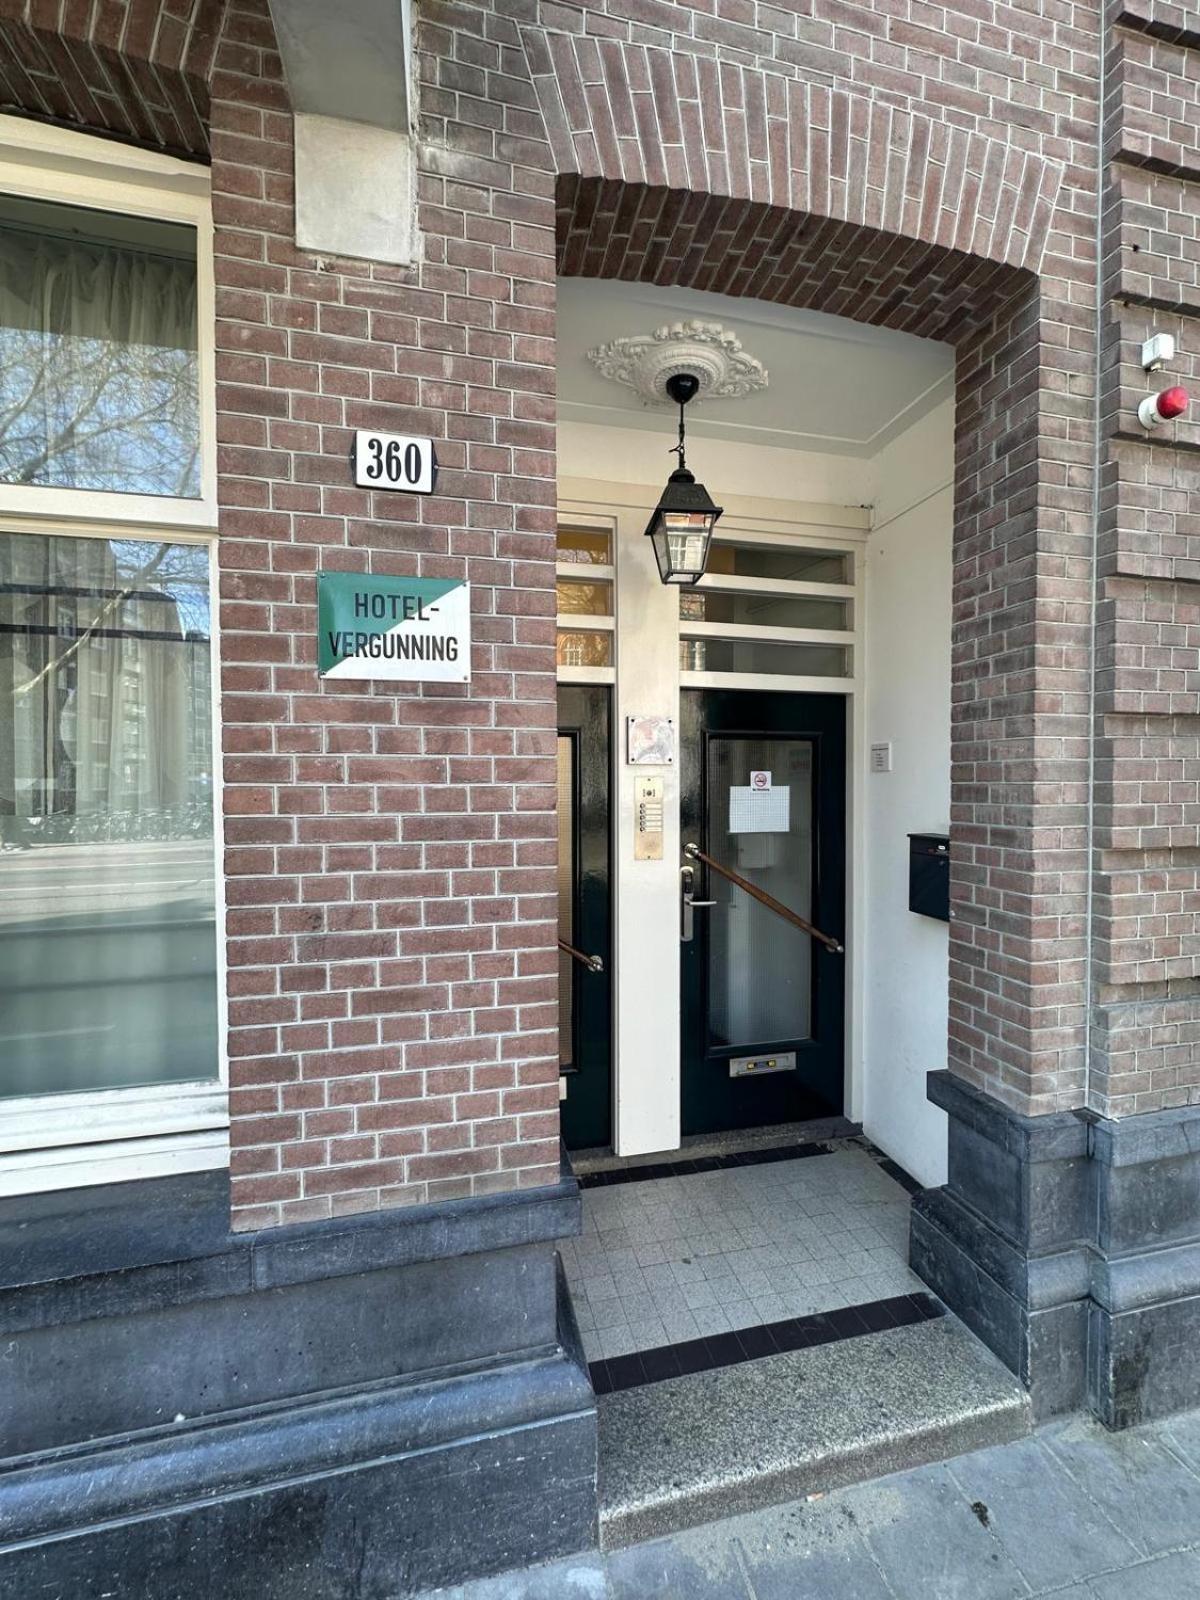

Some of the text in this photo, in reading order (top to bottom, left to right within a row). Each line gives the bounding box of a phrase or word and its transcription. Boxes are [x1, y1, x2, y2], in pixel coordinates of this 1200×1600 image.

[366, 438, 422, 484] 360
[354, 592, 440, 621] HOTEL-
[328, 631, 459, 662] VERGUNNING
